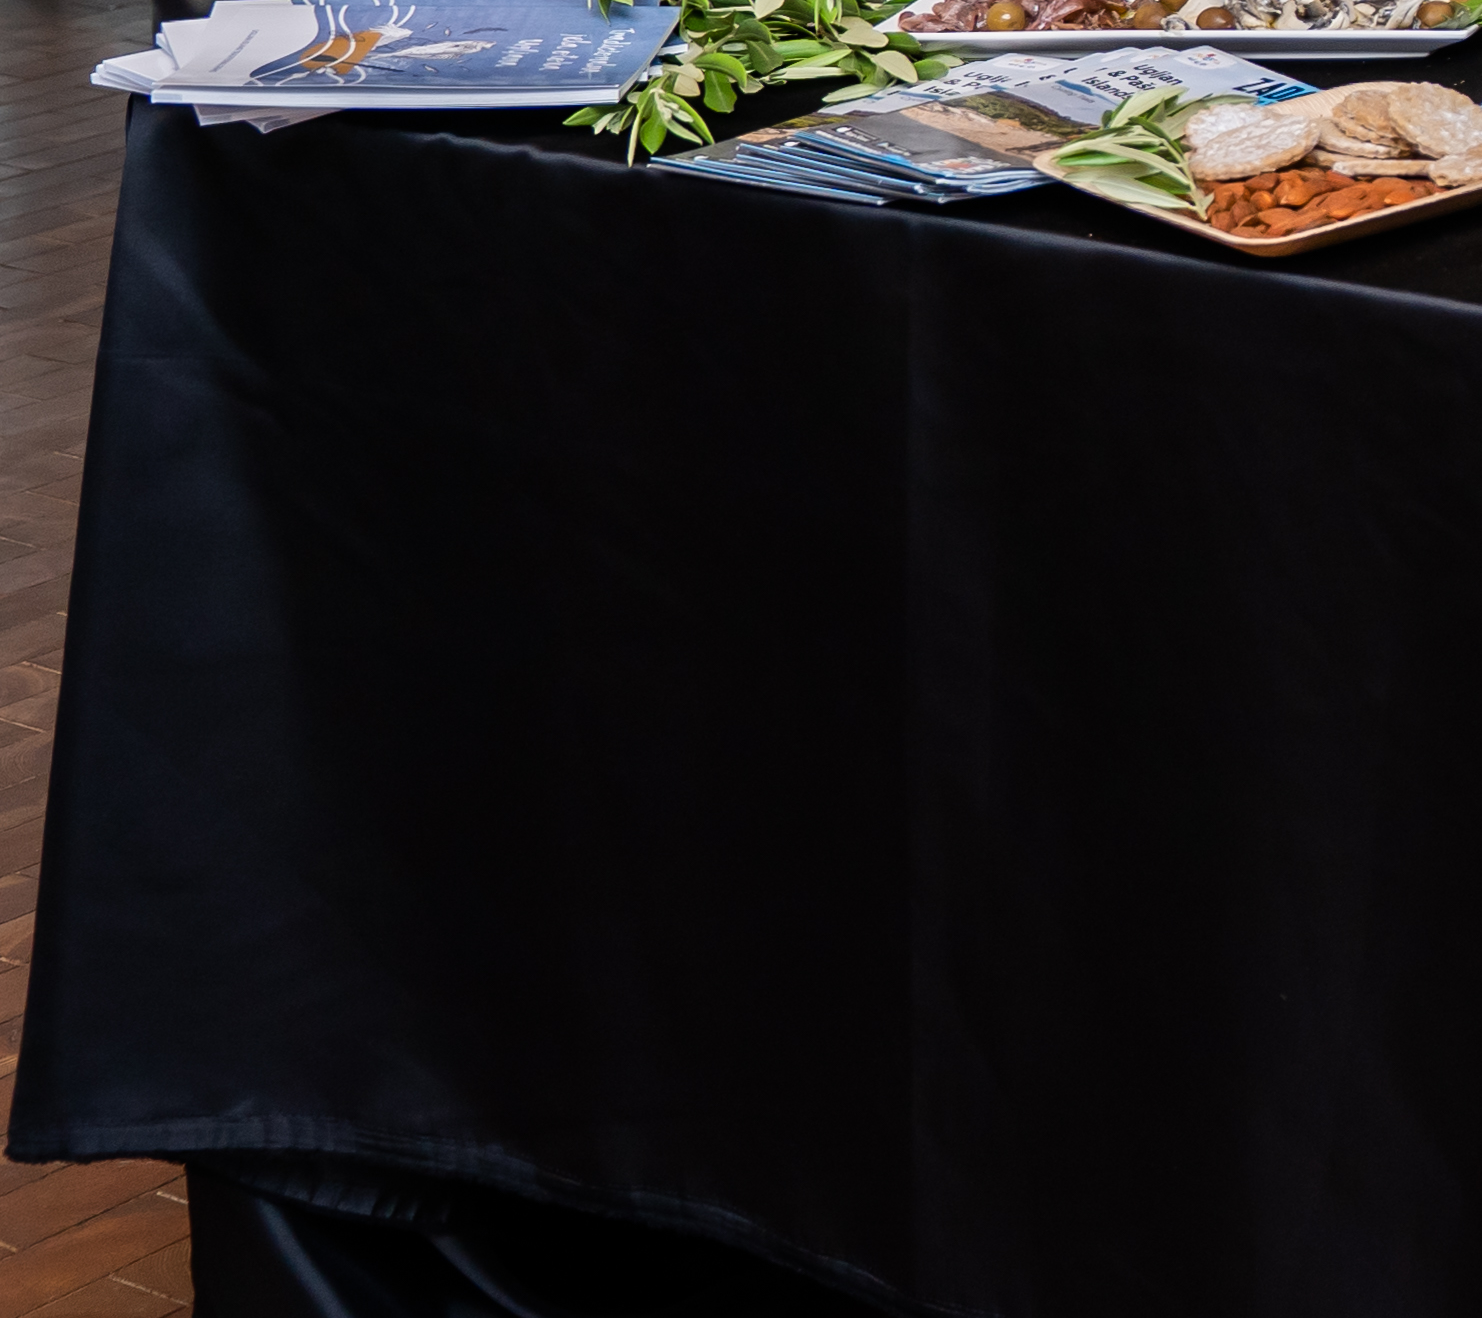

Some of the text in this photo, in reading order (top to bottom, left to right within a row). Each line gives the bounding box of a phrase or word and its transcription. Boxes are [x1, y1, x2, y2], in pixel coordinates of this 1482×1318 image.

[963, 71, 1012, 84] Uglj
[1107, 68, 1156, 91] & Paš
[1134, 64, 1183, 86] Ugljan
